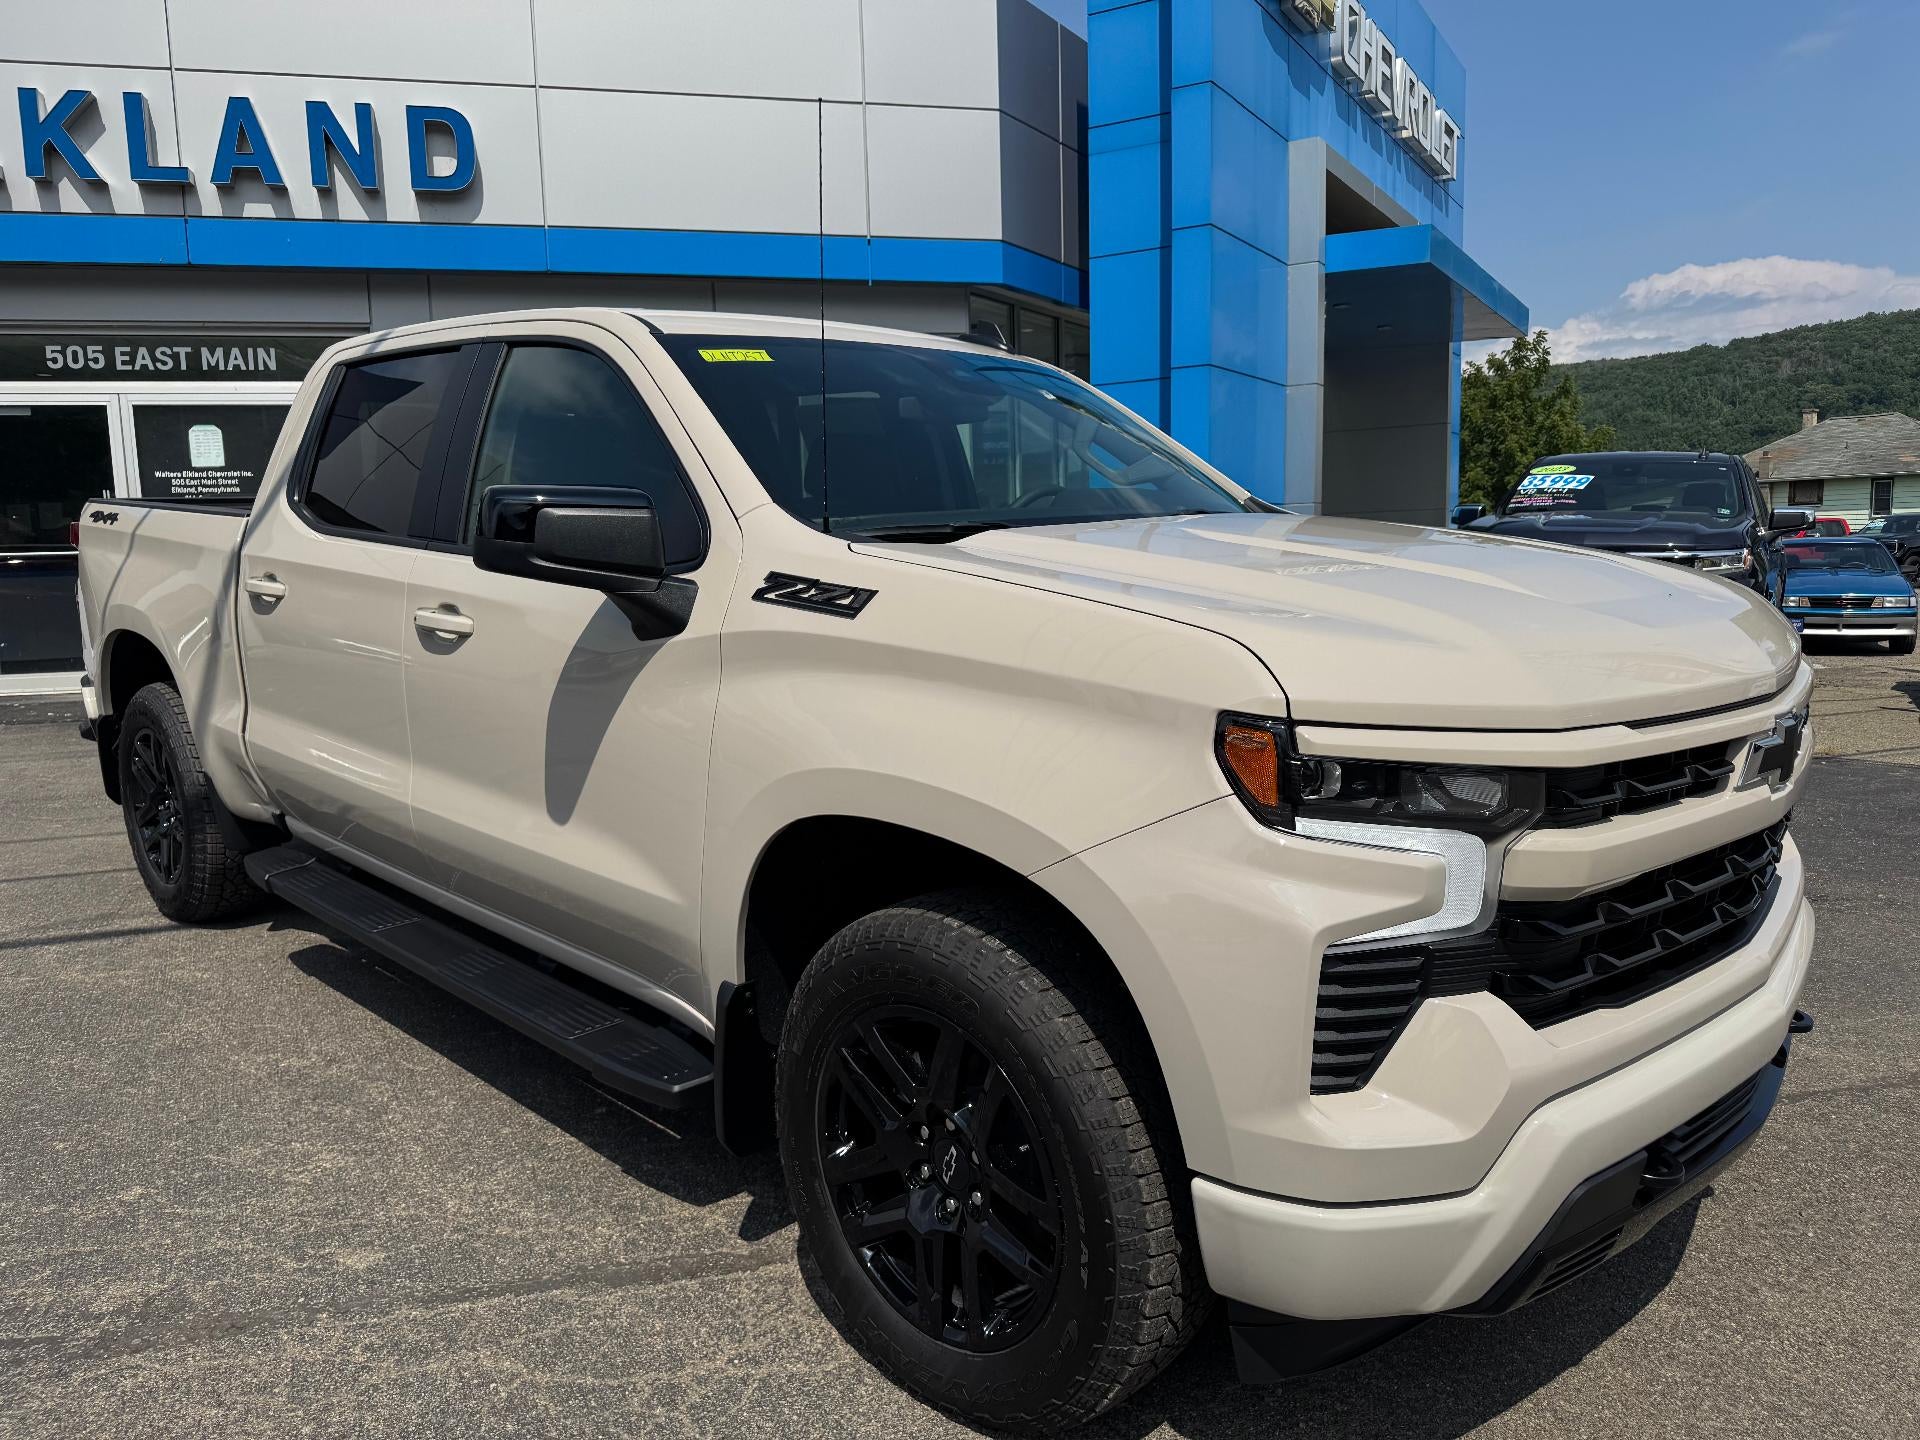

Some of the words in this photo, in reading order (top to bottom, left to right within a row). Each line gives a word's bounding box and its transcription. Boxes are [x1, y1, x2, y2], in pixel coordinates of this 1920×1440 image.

[1331, 0, 1465, 181] CHEVROLET
[0, 86, 478, 194] KLAND
[45, 345, 105, 370] 505
[114, 346, 192, 371] EAST
[201, 347, 277, 371] MAIN
[154, 470, 182, 478] Walters
[182, 470, 207, 478] Elkland
[186, 478, 200, 486] East
[1520, 475, 1591, 487] 35999
[197, 486, 241, 494] Pennsylvania
[751, 570, 880, 621] Z71
